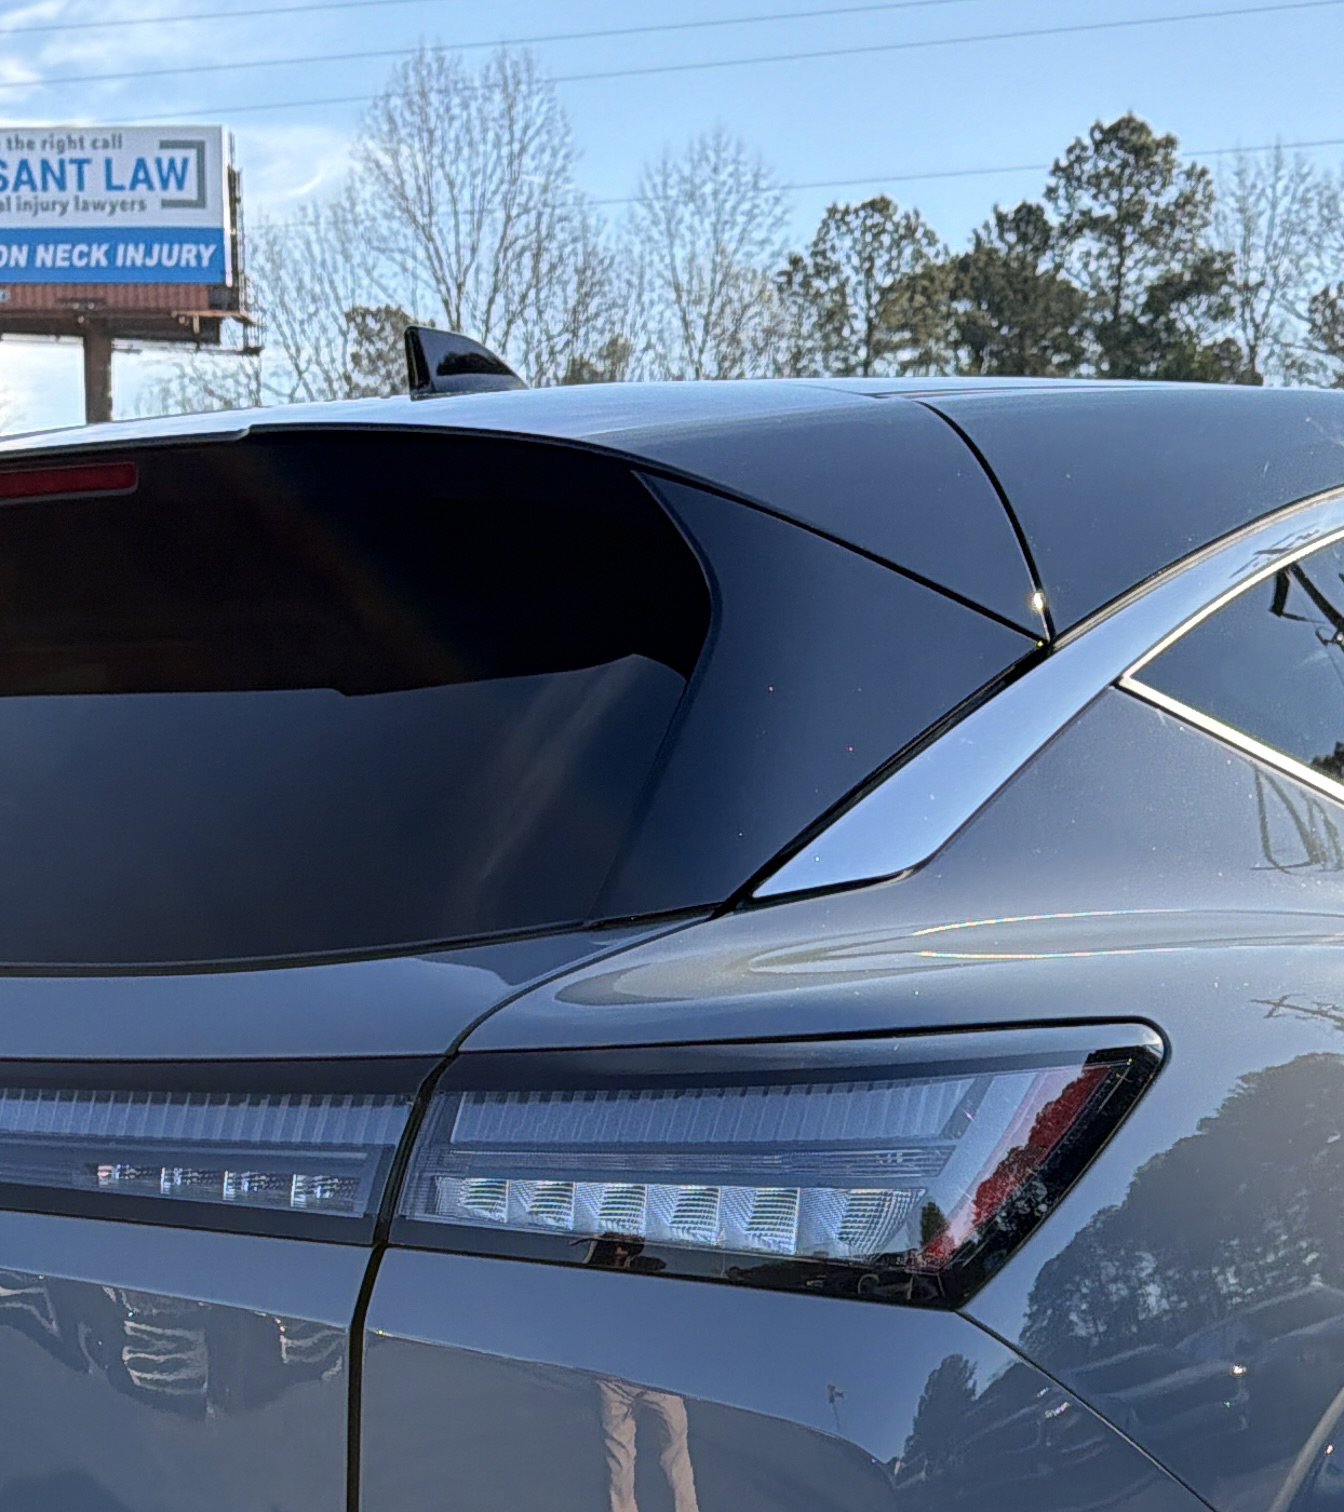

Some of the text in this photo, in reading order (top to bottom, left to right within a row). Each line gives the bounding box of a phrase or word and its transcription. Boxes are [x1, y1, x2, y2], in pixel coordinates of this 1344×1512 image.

[6, 134, 36, 150] the
[41, 133, 85, 153] right
[91, 133, 123, 150] call
[104, 157, 189, 191] LAW
[15, 196, 70, 217] injury
[74, 196, 147, 216] lawyers
[35, 244, 110, 268] NECK
[115, 243, 217, 267] INJURY
